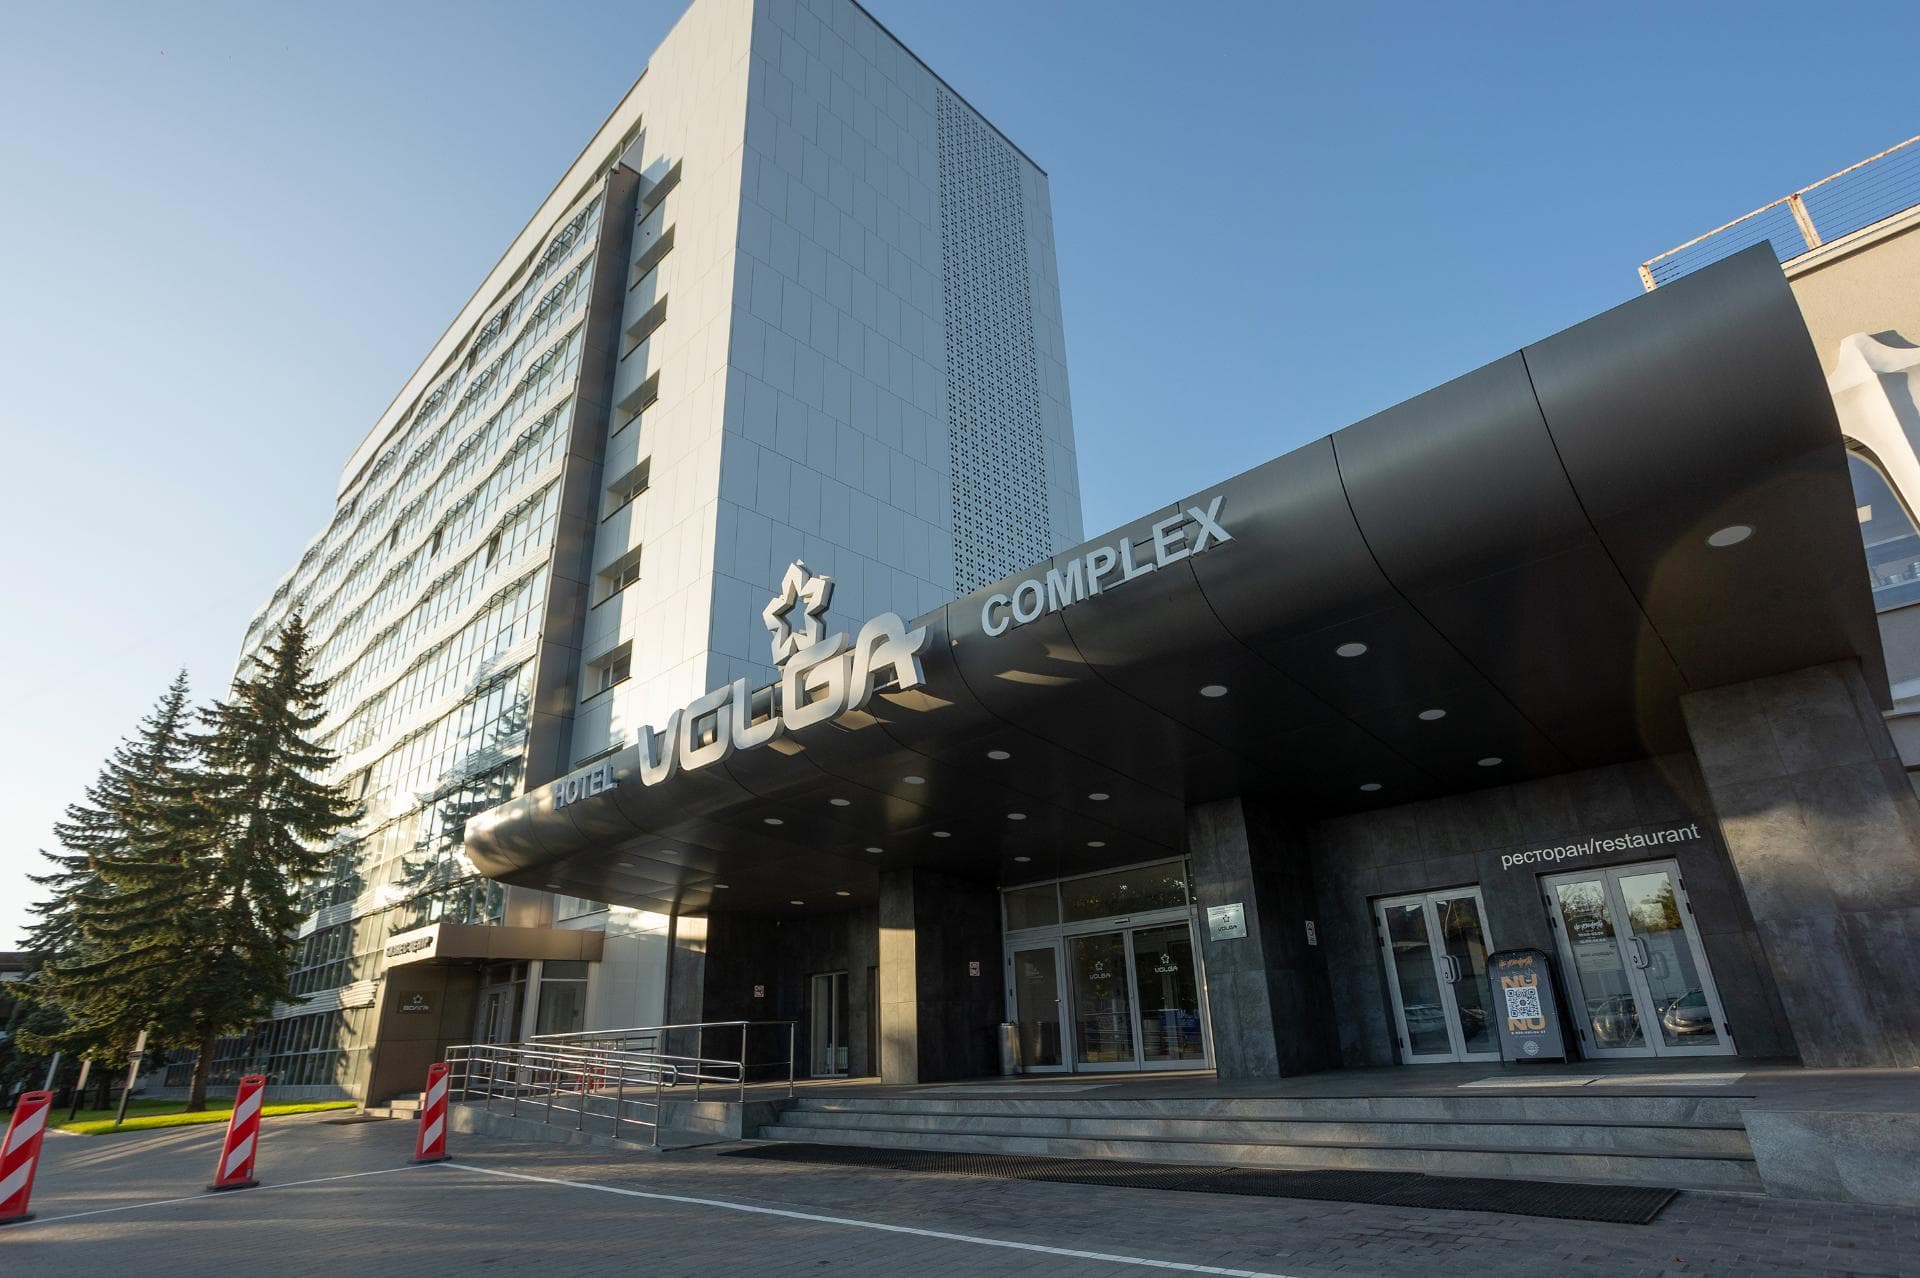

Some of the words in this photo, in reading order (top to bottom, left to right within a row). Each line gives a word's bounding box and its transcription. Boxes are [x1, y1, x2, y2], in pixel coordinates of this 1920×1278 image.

[552, 763, 619, 811] HOTEL
[637, 612, 933, 787] VOLGA
[981, 495, 1236, 637] COMPLEX
[1501, 823, 1701, 870] ресторан/restaurant
